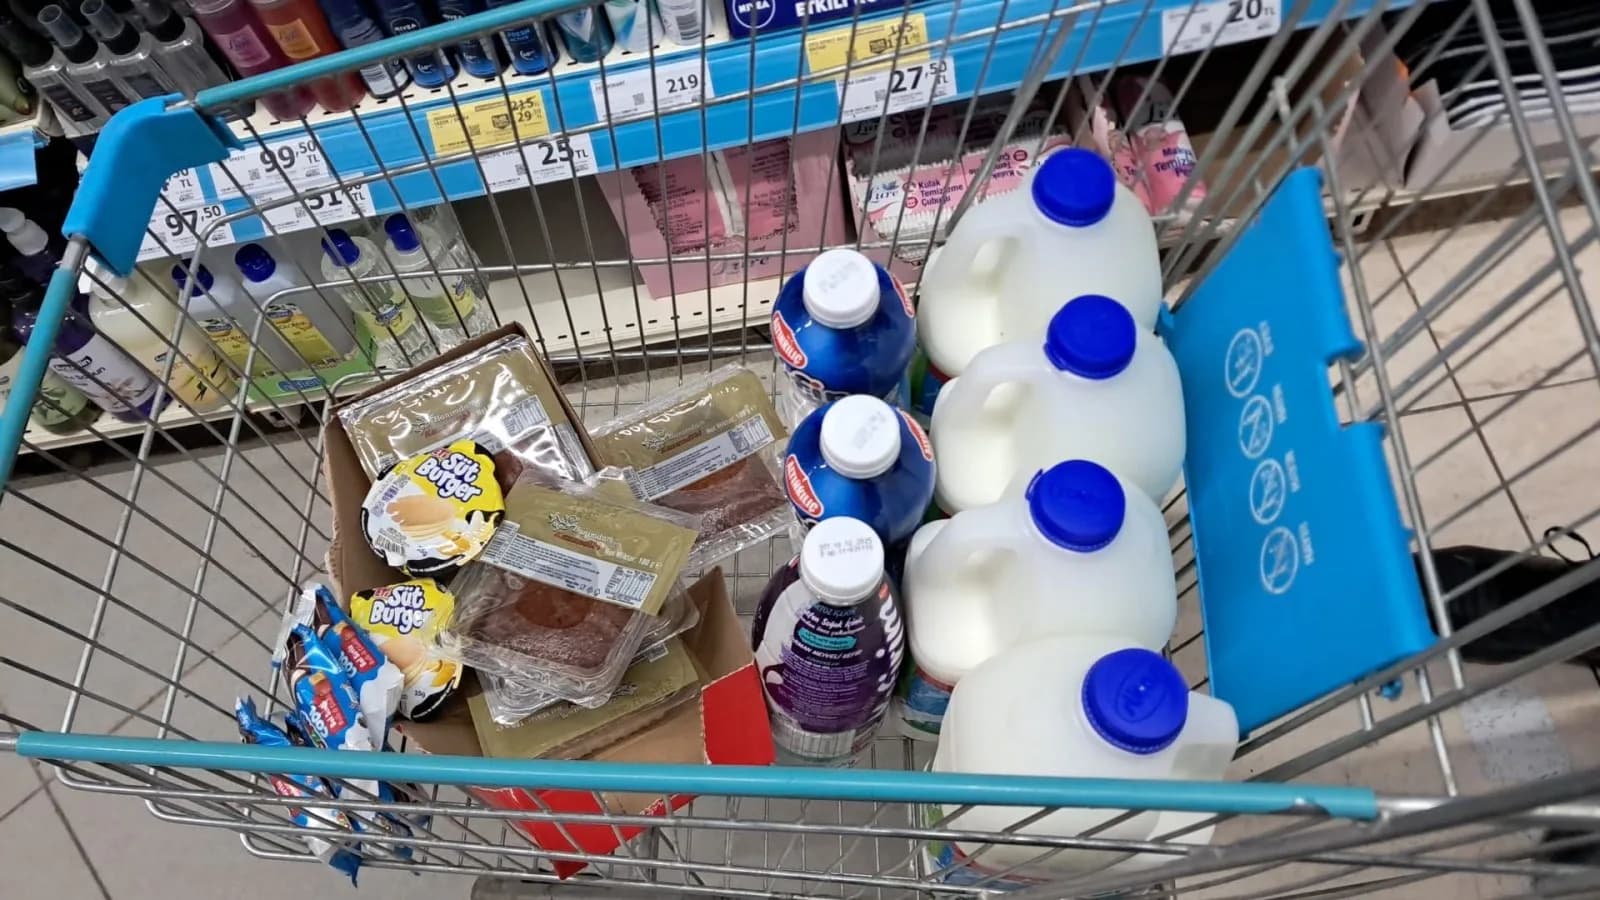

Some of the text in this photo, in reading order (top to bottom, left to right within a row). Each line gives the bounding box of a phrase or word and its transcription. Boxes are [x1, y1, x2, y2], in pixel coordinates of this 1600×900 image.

[1228, 0, 1262, 23] 20
[666, 74, 699, 93] 219
[307, 154, 320, 164] TL
[538, 137, 575, 166] 25
[918, 179, 941, 190] Kulak
[920, 184, 964, 198] Temizeme
[415, 457, 482, 502] Burger
[440, 453, 480, 483] Süt
[388, 586, 425, 609] Süt
[370, 600, 434, 633] Burger
